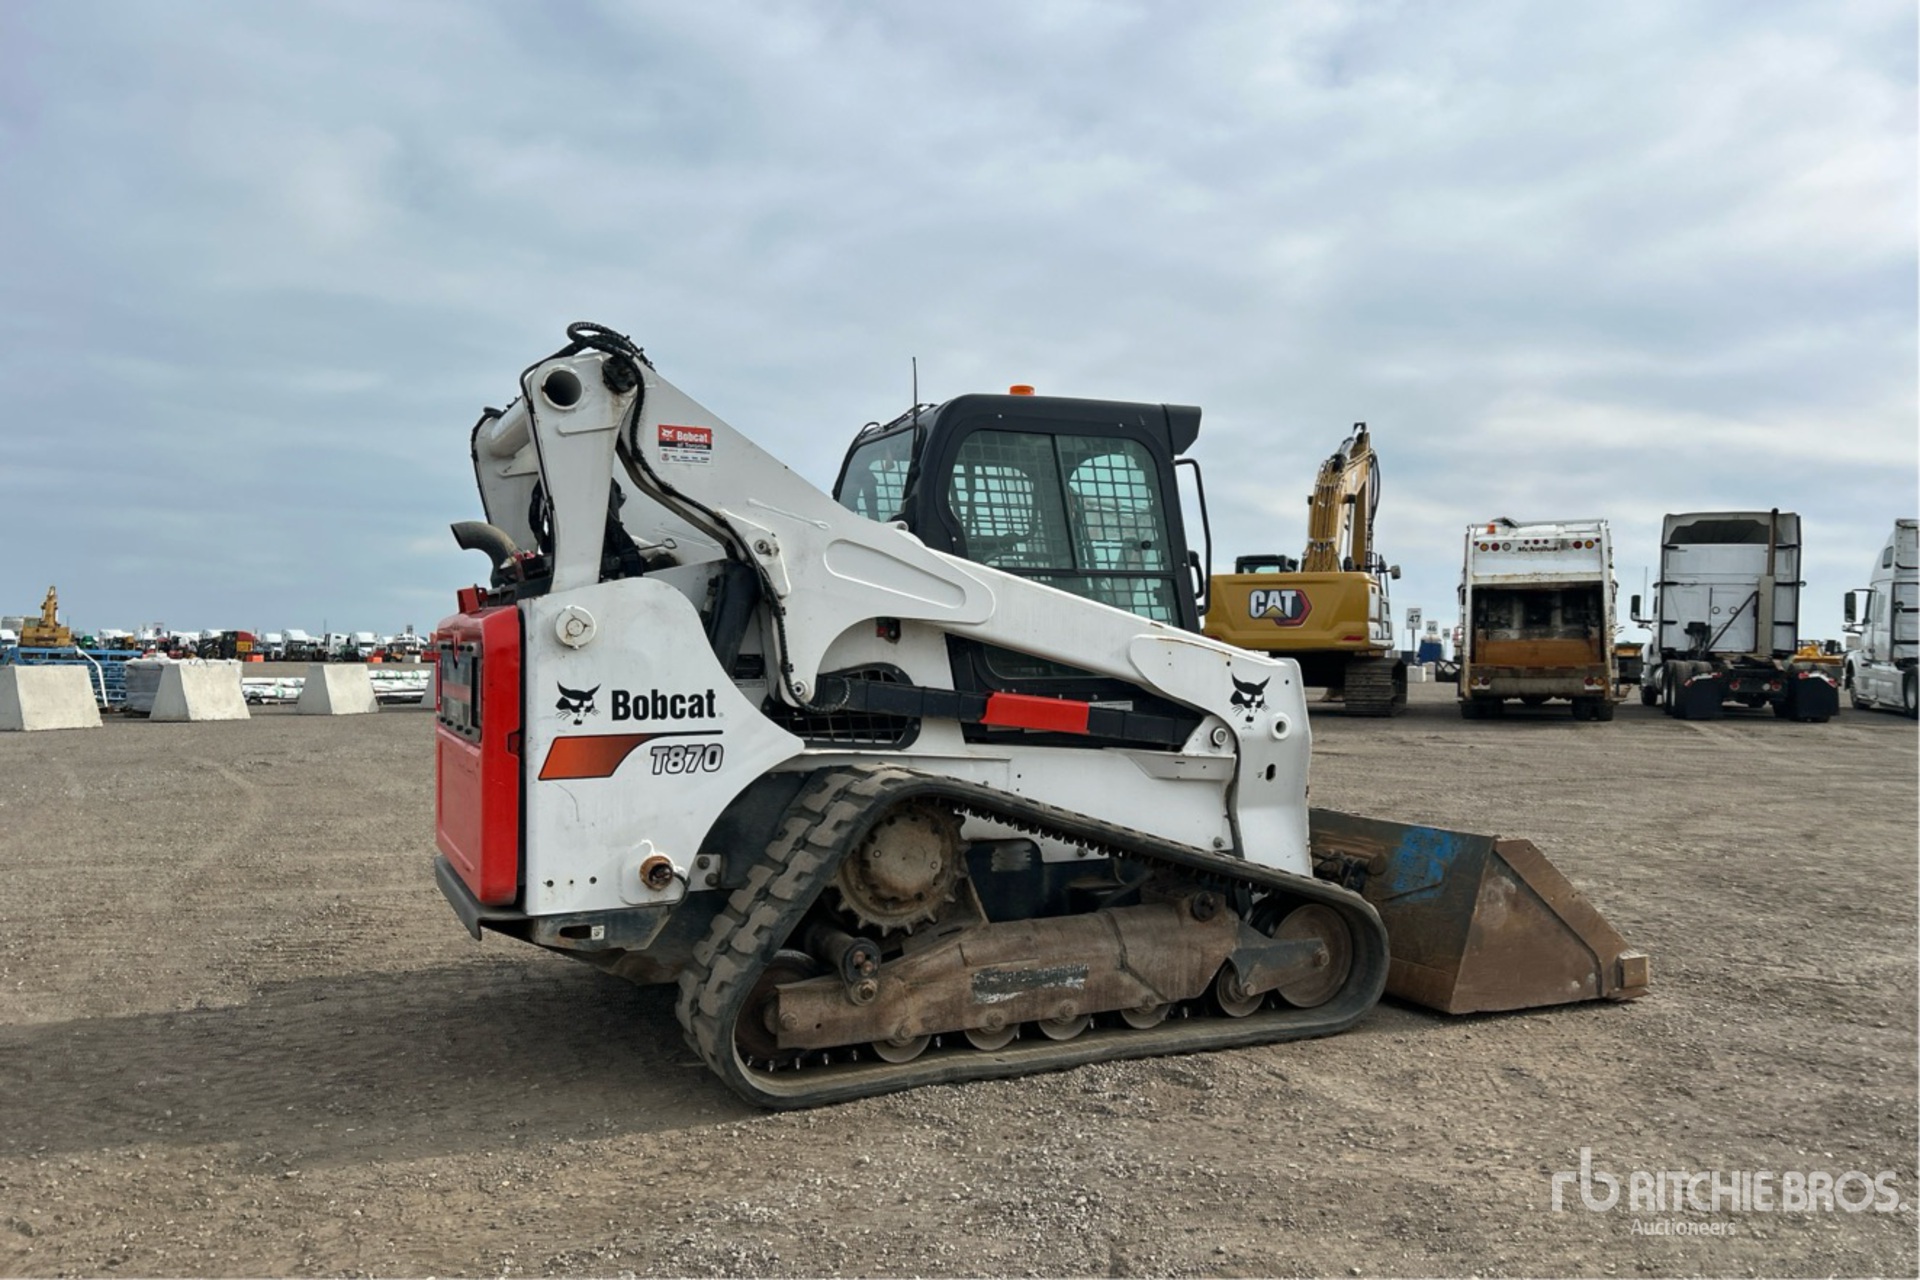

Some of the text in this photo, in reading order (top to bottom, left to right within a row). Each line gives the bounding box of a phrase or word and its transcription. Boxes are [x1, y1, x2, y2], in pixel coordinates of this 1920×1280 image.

[676, 430, 708, 443] Bobcat
[1250, 590, 1297, 619] CAT
[1408, 614, 1421, 624] 47
[611, 689, 716, 721] Bobcat
[650, 743, 724, 775] T870
